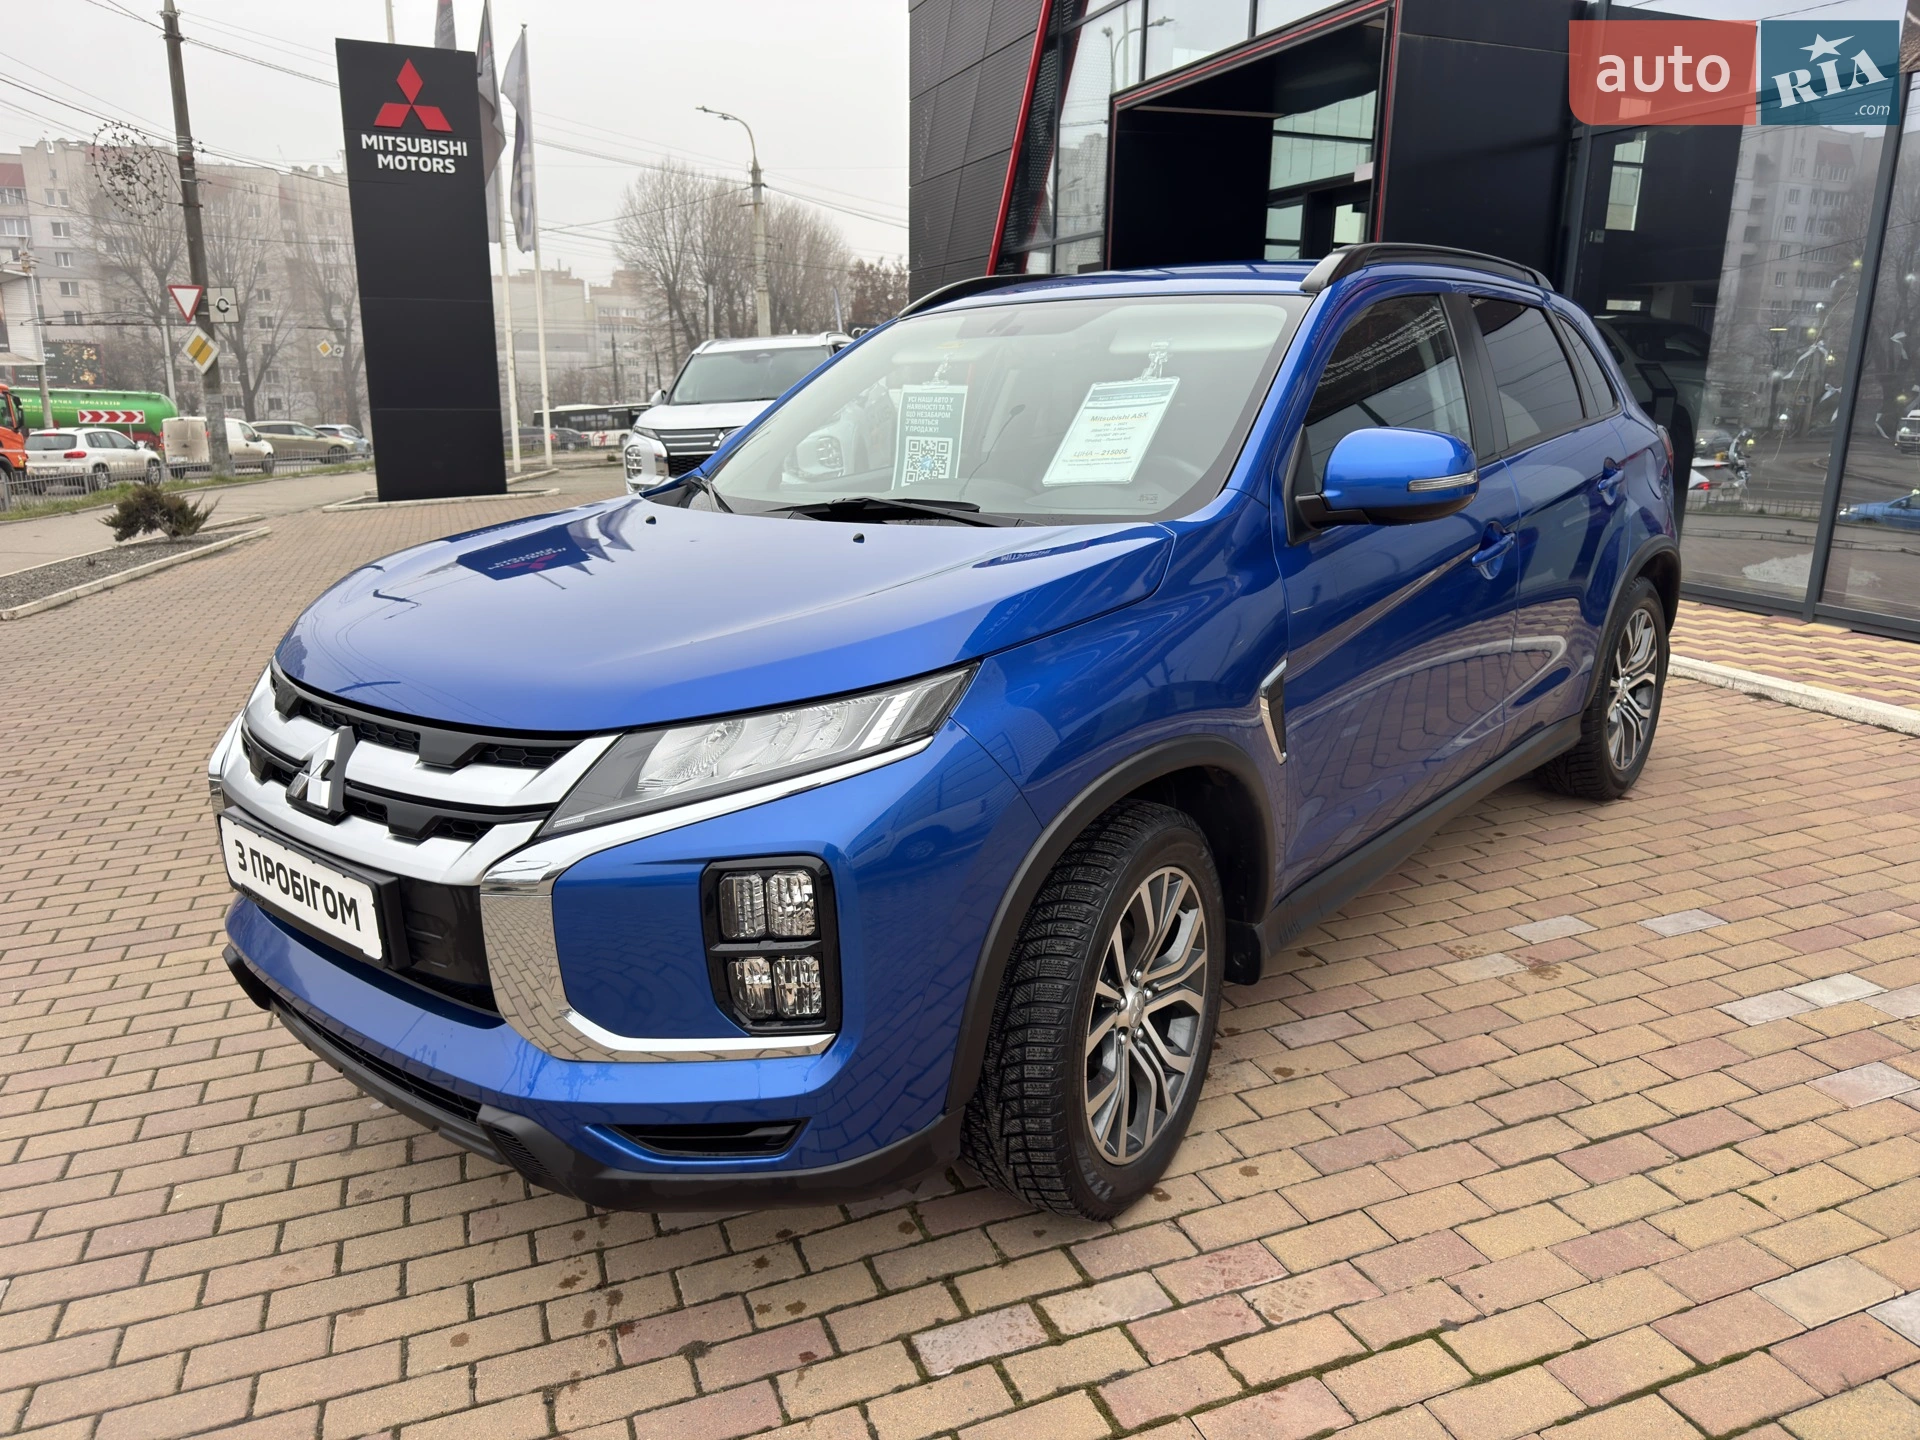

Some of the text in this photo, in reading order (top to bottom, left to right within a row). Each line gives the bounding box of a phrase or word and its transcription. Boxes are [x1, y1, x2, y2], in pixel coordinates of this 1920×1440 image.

[361, 133, 468, 157] MITSUBISHI
[377, 154, 456, 174] MOTORS
[1090, 413, 1131, 422] Mitsubishi
[1101, 448, 1128, 456] 21500$
[234, 839, 361, 932] З ПРОБІГОМ
